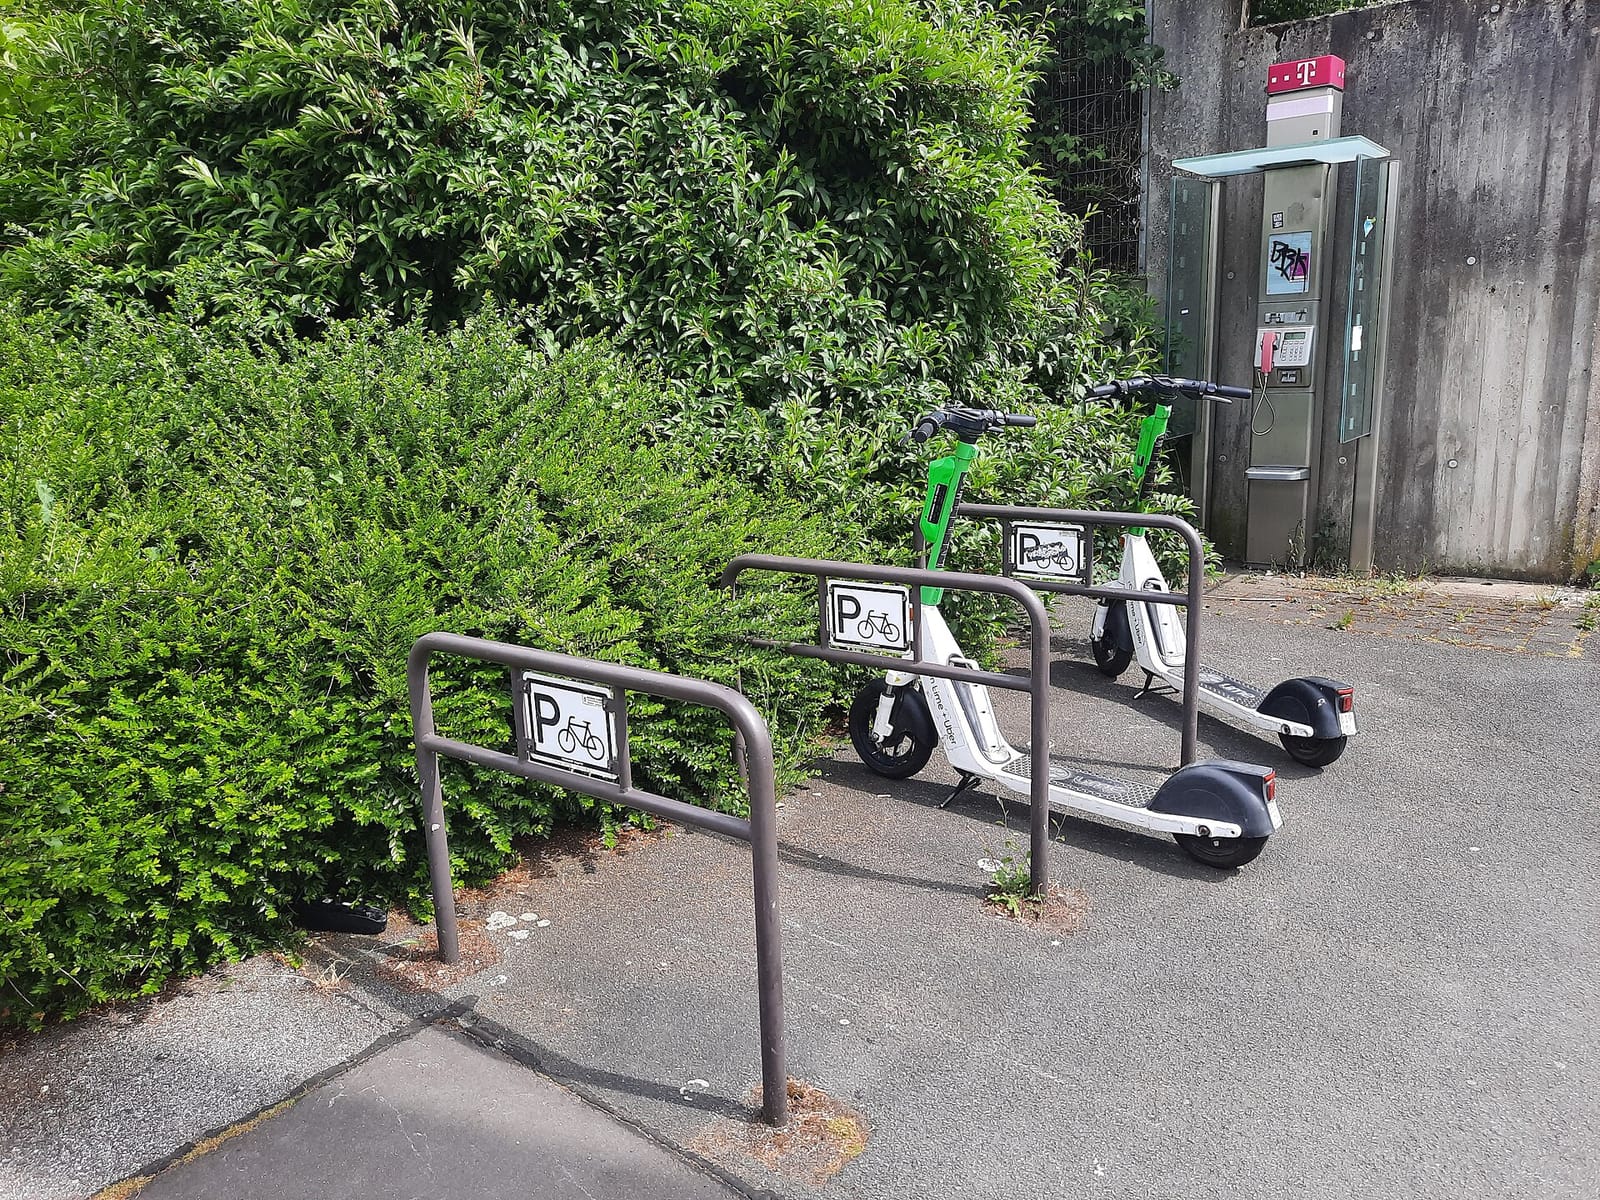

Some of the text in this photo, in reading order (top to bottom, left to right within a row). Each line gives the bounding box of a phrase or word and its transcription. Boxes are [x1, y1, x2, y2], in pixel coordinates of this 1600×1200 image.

[1297, 60, 1316, 86] T
[1020, 532, 1040, 565] P
[837, 594, 861, 634] P
[533, 692, 560, 744] P
[931, 685, 944, 711] Lime
[943, 719, 956, 745] Uber
